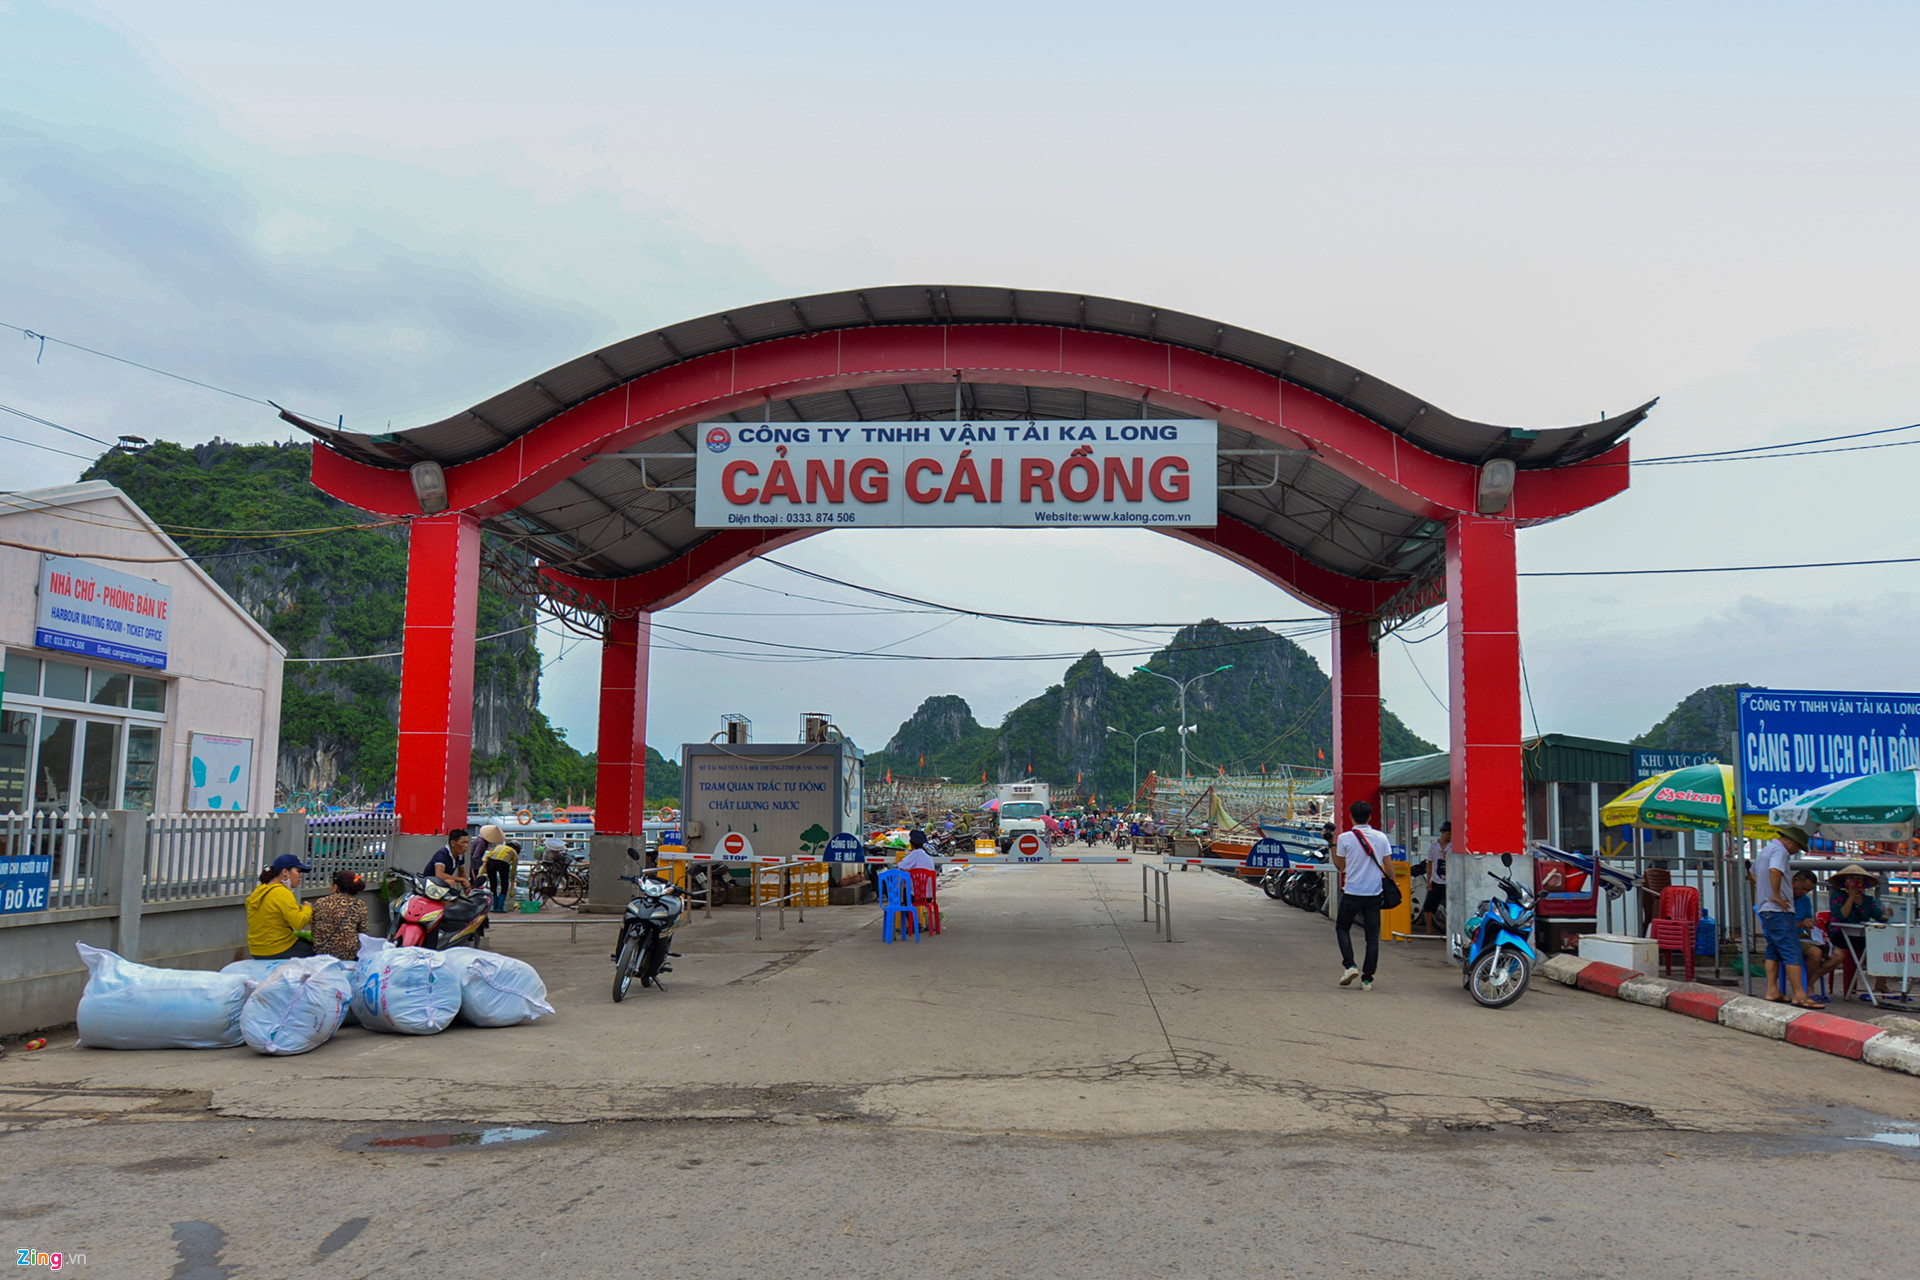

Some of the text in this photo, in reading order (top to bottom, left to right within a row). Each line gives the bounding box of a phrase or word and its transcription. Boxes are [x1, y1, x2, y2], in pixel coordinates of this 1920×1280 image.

[738, 425, 810, 443] CÔNG
[818, 428, 850, 442] TY
[861, 428, 930, 442] TNHH
[939, 424, 996, 445] VẬN
[1004, 422, 1049, 441] TẢI
[1059, 426, 1097, 441] KA
[1105, 425, 1178, 441] LONG
[721, 445, 1190, 505] CẢNG CÁI RỒNG
[728, 513, 750, 523] Điện
[753, 513, 778, 523] thoại
[786, 513, 813, 523] 0333.
[816, 513, 834, 522] 874
[837, 513, 855, 522] 506
[50, 571, 72, 597] NHÀ
[74, 577, 96, 602] CHỜ
[102, 585, 134, 612] PHÒNG
[136, 593, 155, 618] BÁN
[51, 606, 79, 624] HARBOUR
[81, 613, 105, 629] WAITING
[106, 619, 122, 633] ROOM
[126, 623, 144, 638] TICKET
[144, 628, 162, 641] OFFICE
[1750, 697, 1780, 712] CÔNG
[1783, 700, 1797, 711] TY
[1800, 701, 1828, 713] TNHH
[1831, 699, 1854, 716] VẬN
[1876, 702, 1891, 714] KA
[1747, 719, 1790, 772] CẢNG
[1793, 734, 1815, 773] DU
[1819, 734, 1855, 779] LỊCH
[1858, 728, 1885, 774] CÁI
[1640, 754, 1665, 767] KHU
[1668, 754, 1691, 769] VỰC
[700, 779, 827, 792] TRẠM QUAN TRẮC TỰ ĐỘNG
[709, 798, 800, 811] CHẤT LƯỢNG NƯỚC
[1655, 787, 1722, 804] Meizan
[834, 852, 842, 861] XE
[5, 880, 24, 910] ĐỖ
[27, 887, 45, 908] XE
